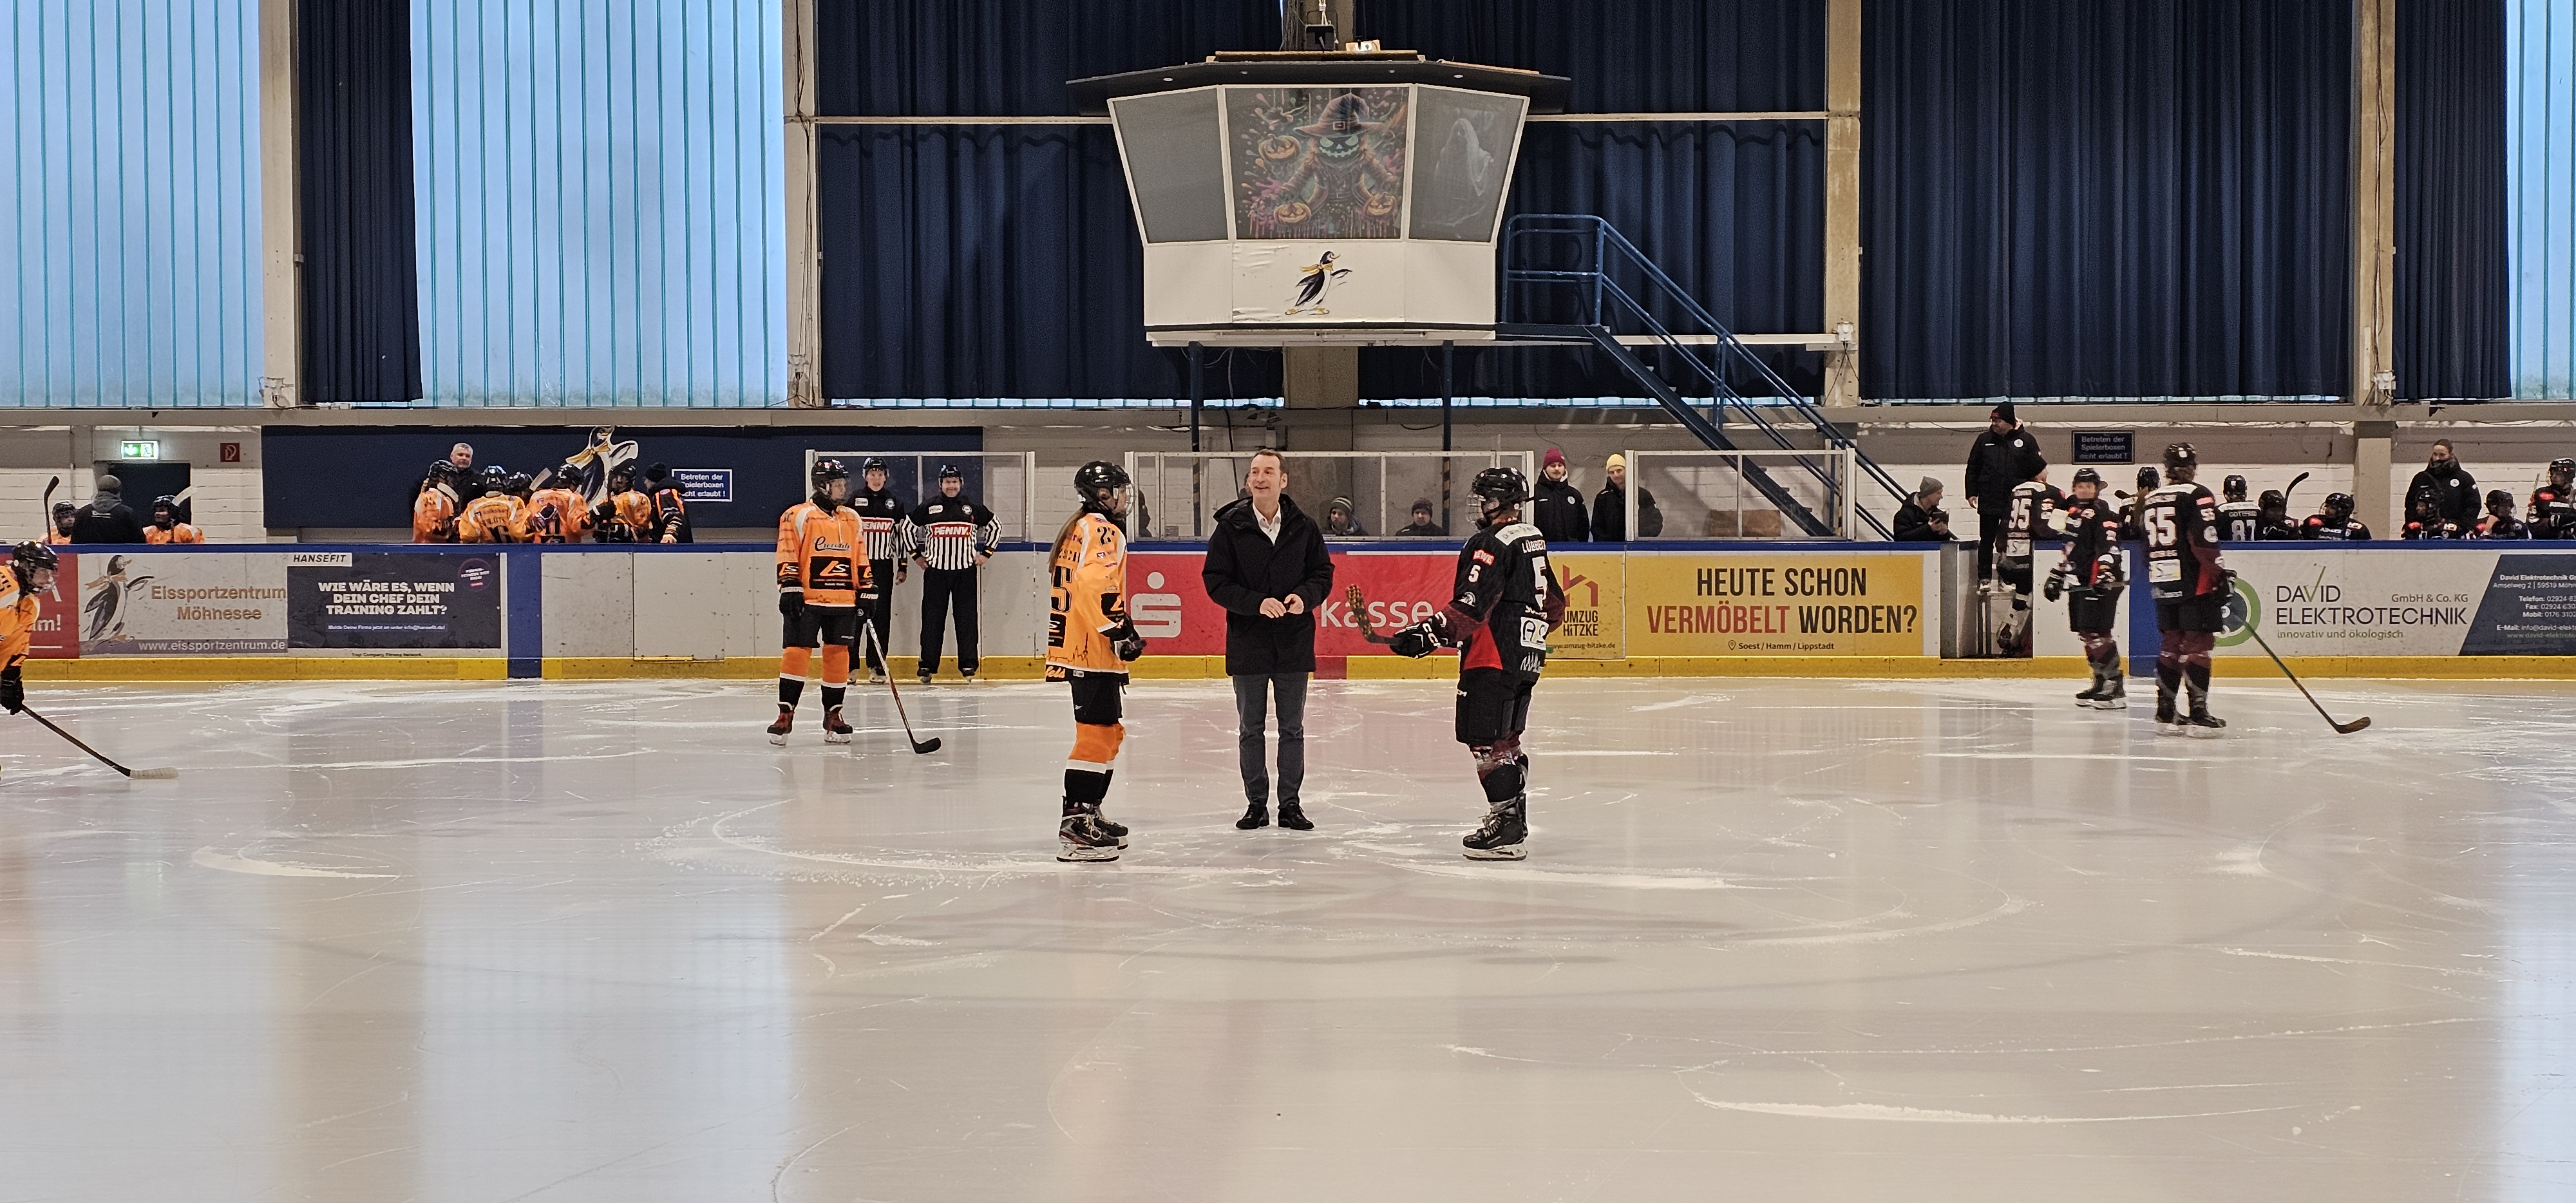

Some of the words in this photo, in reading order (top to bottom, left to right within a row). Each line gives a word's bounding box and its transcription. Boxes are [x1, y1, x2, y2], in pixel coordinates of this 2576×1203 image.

[1468, 564, 1481, 583] 5
[318, 582, 346, 592] WIE
[348, 580, 389, 592] WÄRE
[391, 582, 412, 593] ES,
[413, 582, 455, 592] WENN
[1697, 568, 1775, 596] HEUTE
[1785, 568, 1866, 596] SCHON
[151, 585, 287, 602] Eissportzentrum
[333, 594, 366, 603] DEIN
[369, 594, 404, 603] CHEF
[406, 594, 440, 603] DEIN
[2391, 594, 2423, 603] GmbH
[2426, 594, 2434, 603] &
[2436, 594, 2452, 603] Co.
[2454, 594, 2468, 603] KG
[177, 606, 262, 620] Möhnesee
[326, 605, 394, 615] TRAINING
[397, 605, 448, 615] ZAHLT?
[1564, 610, 1598, 623] UMZUG
[2276, 607, 2468, 625] ELEKTROTECHNIK
[1647, 600, 1790, 634] VERMÖBELT
[1799, 605, 1917, 634] WORDEN?
[2277, 629, 2323, 639] innovativ
[2327, 629, 2346, 638] und
[2349, 629, 2403, 641] ökologisch
[138, 640, 286, 652] www.eissportzentrum.de
[1797, 643, 1835, 651] Lippstadt
